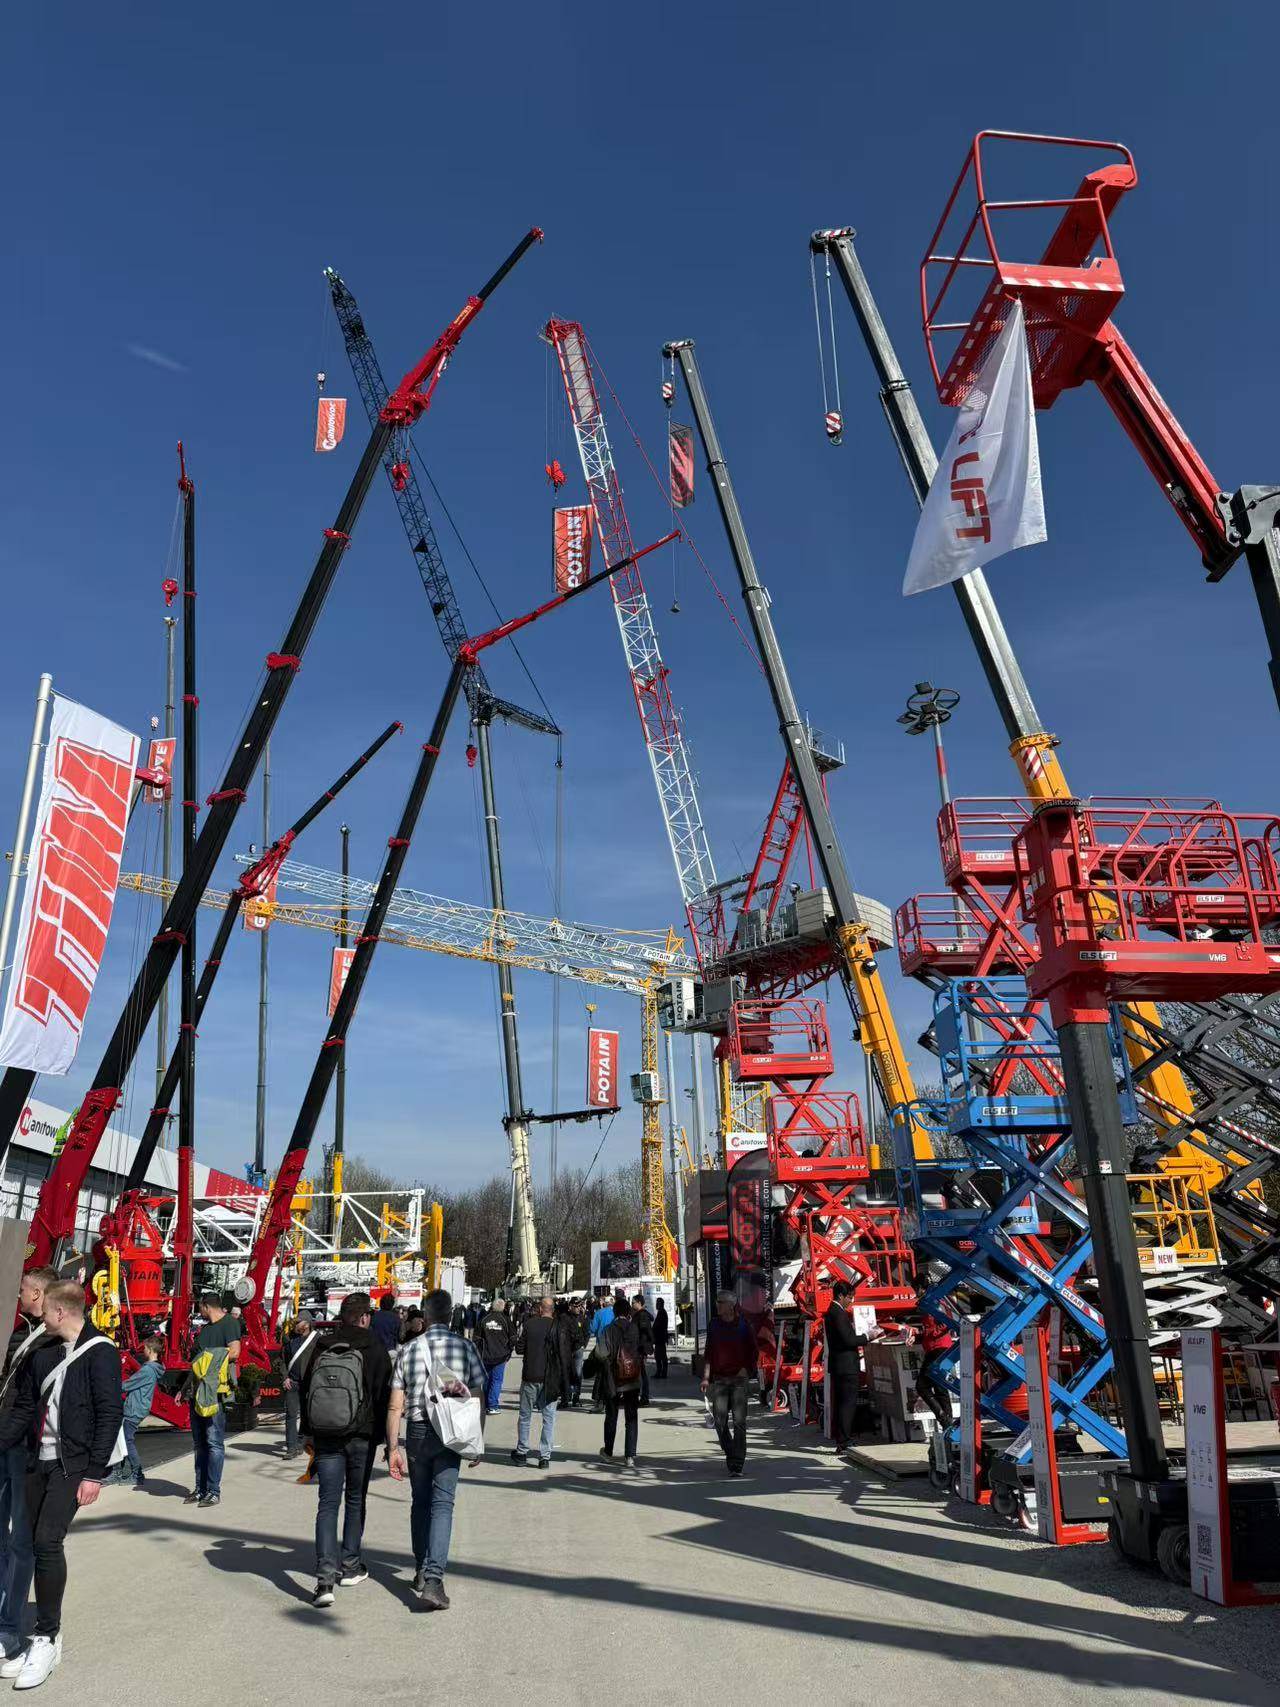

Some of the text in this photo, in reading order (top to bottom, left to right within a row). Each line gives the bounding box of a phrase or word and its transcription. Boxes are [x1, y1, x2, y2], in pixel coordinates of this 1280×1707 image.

[951, 452, 991, 544] LIFT
[567, 515, 583, 588] POTAIN
[647, 950, 671, 960] POTAIN
[1080, 952, 1117, 960] ELS LIFT
[1209, 953, 1227, 962] VM6
[676, 981, 685, 1020] POTAIN
[598, 1037, 610, 1104] POTAIN
[984, 1107, 1017, 1115] ELS LIFT
[1157, 1254, 1173, 1264] NEW
[1033, 1267, 1051, 1281] KEEP
[1062, 1289, 1083, 1307] CLEAR
[1193, 1404, 1206, 1415] VM6
